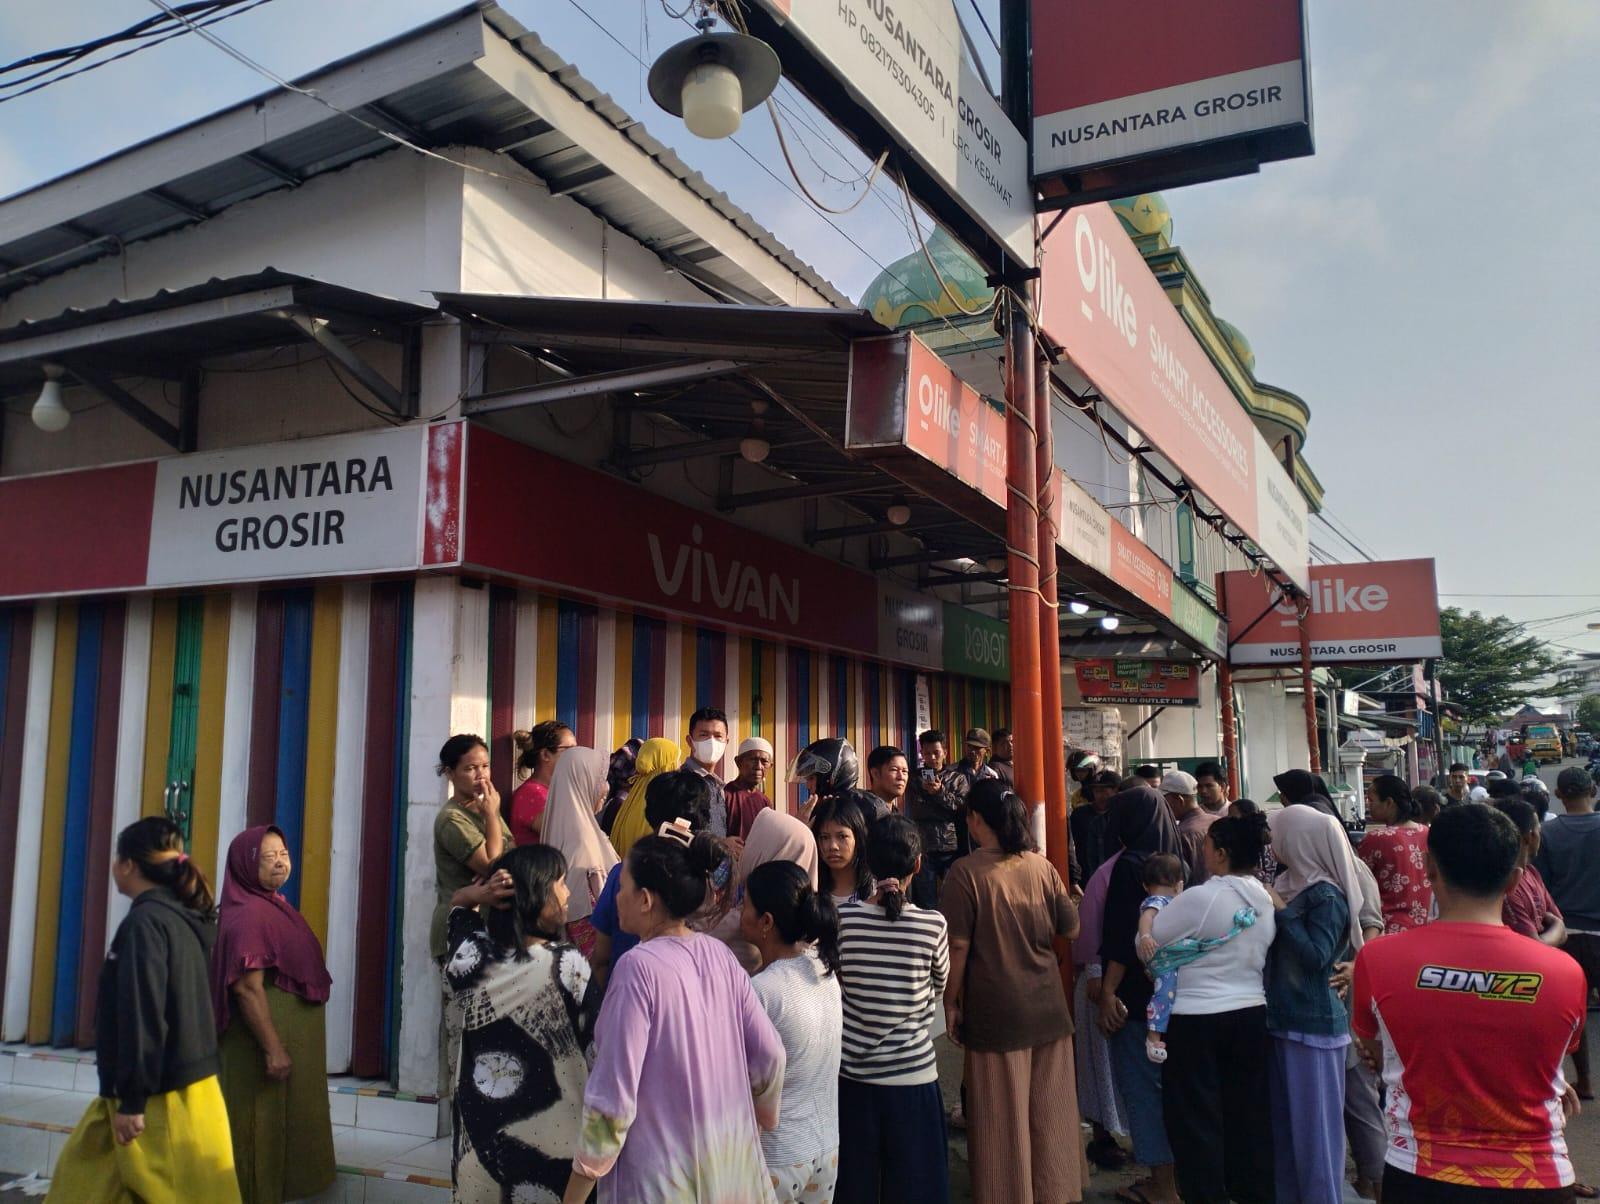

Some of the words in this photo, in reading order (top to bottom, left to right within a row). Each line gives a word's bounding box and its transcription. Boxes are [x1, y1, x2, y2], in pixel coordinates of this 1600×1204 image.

[838, 5, 857, 30] HP
[860, 25, 936, 121] 082175304305
[974, 153, 1013, 208] KERAMAT
[866, 0, 954, 108] USANTARA
[957, 96, 1001, 165] GROSIR
[1051, 106, 1186, 148] NUSANTARA
[1194, 85, 1282, 117] GROSIR
[1075, 213, 1137, 348] Olike
[918, 374, 960, 439] Olike
[1150, 324, 1190, 400] SMART
[1192, 383, 1249, 477] ACCESSORIES
[179, 456, 393, 509] NUSANTARA
[215, 510, 345, 552] GROSIR
[896, 626, 929, 653] GROSIR
[964, 623, 1008, 668] ROBOT
[1270, 645, 1345, 657] NUSATARA
[1348, 643, 1396, 654] GROSIR
[1088, 696, 1128, 704] DAPATKAN
[1418, 966, 1541, 996] SDN72
